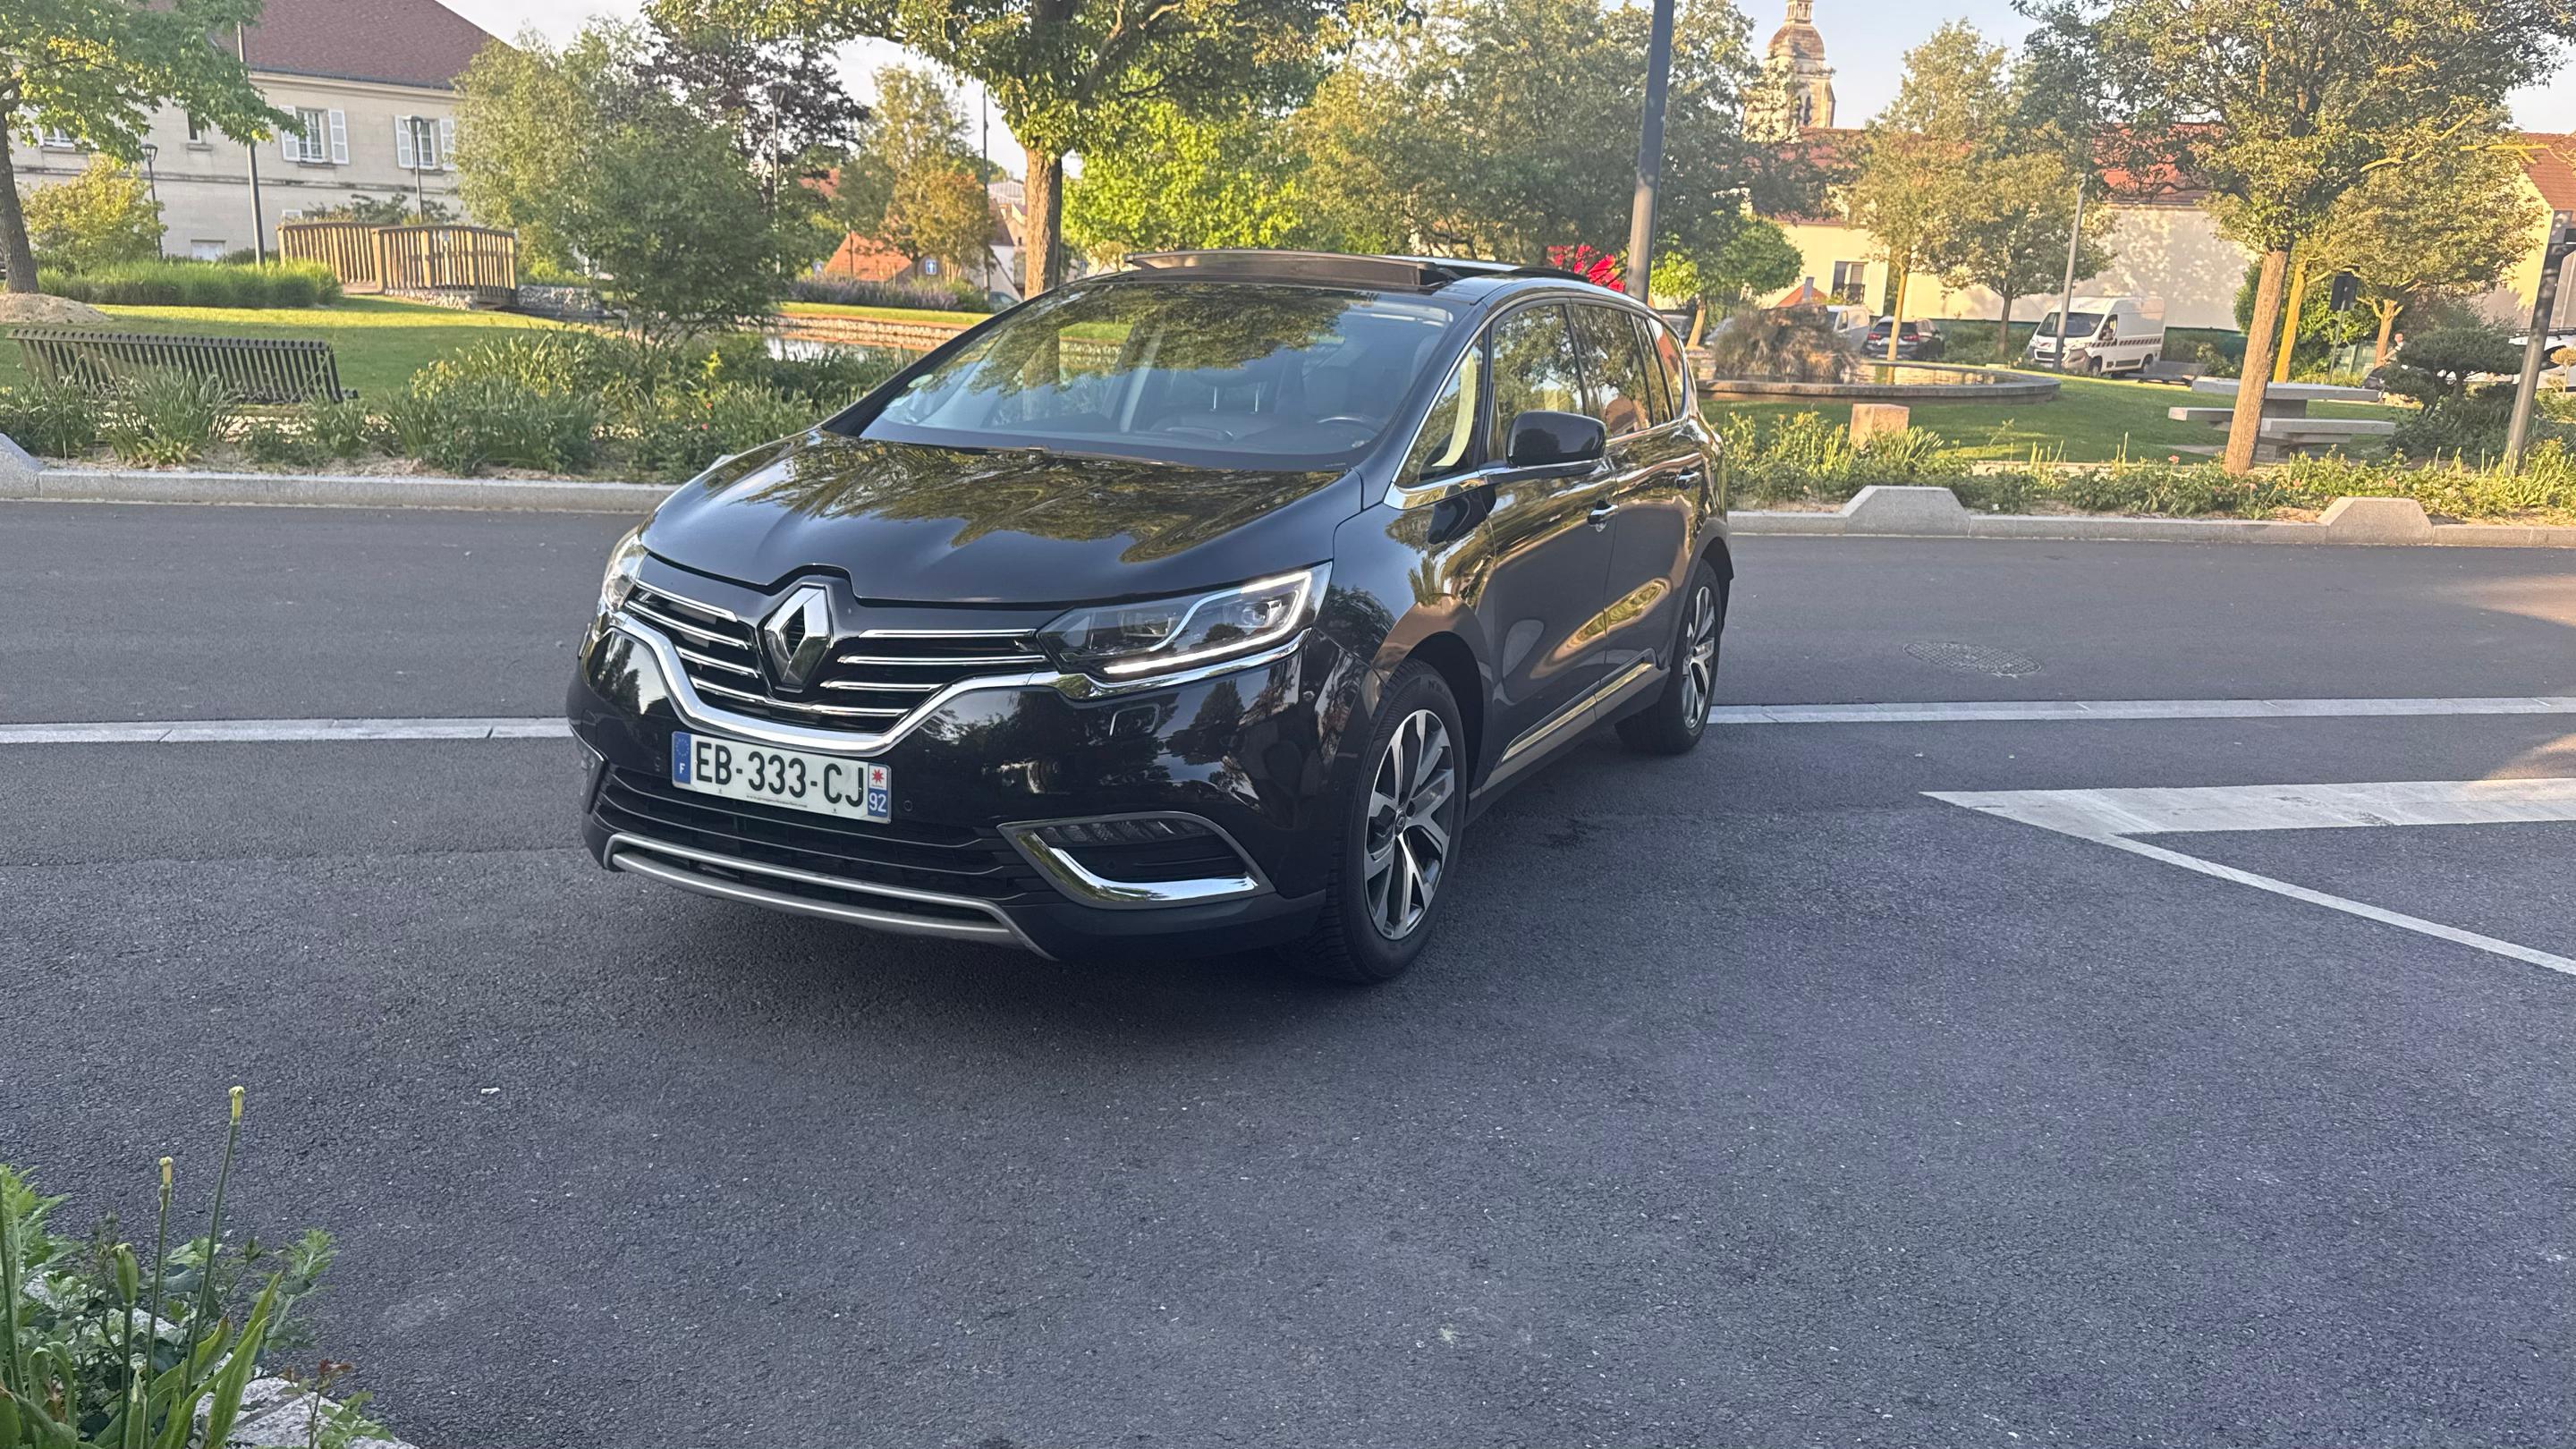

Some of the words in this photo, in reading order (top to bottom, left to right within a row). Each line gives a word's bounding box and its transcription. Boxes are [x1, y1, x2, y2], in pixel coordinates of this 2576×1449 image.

[679, 763, 685, 774] F
[696, 741, 864, 808] EB-333-CJ
[869, 792, 886, 813] 92
